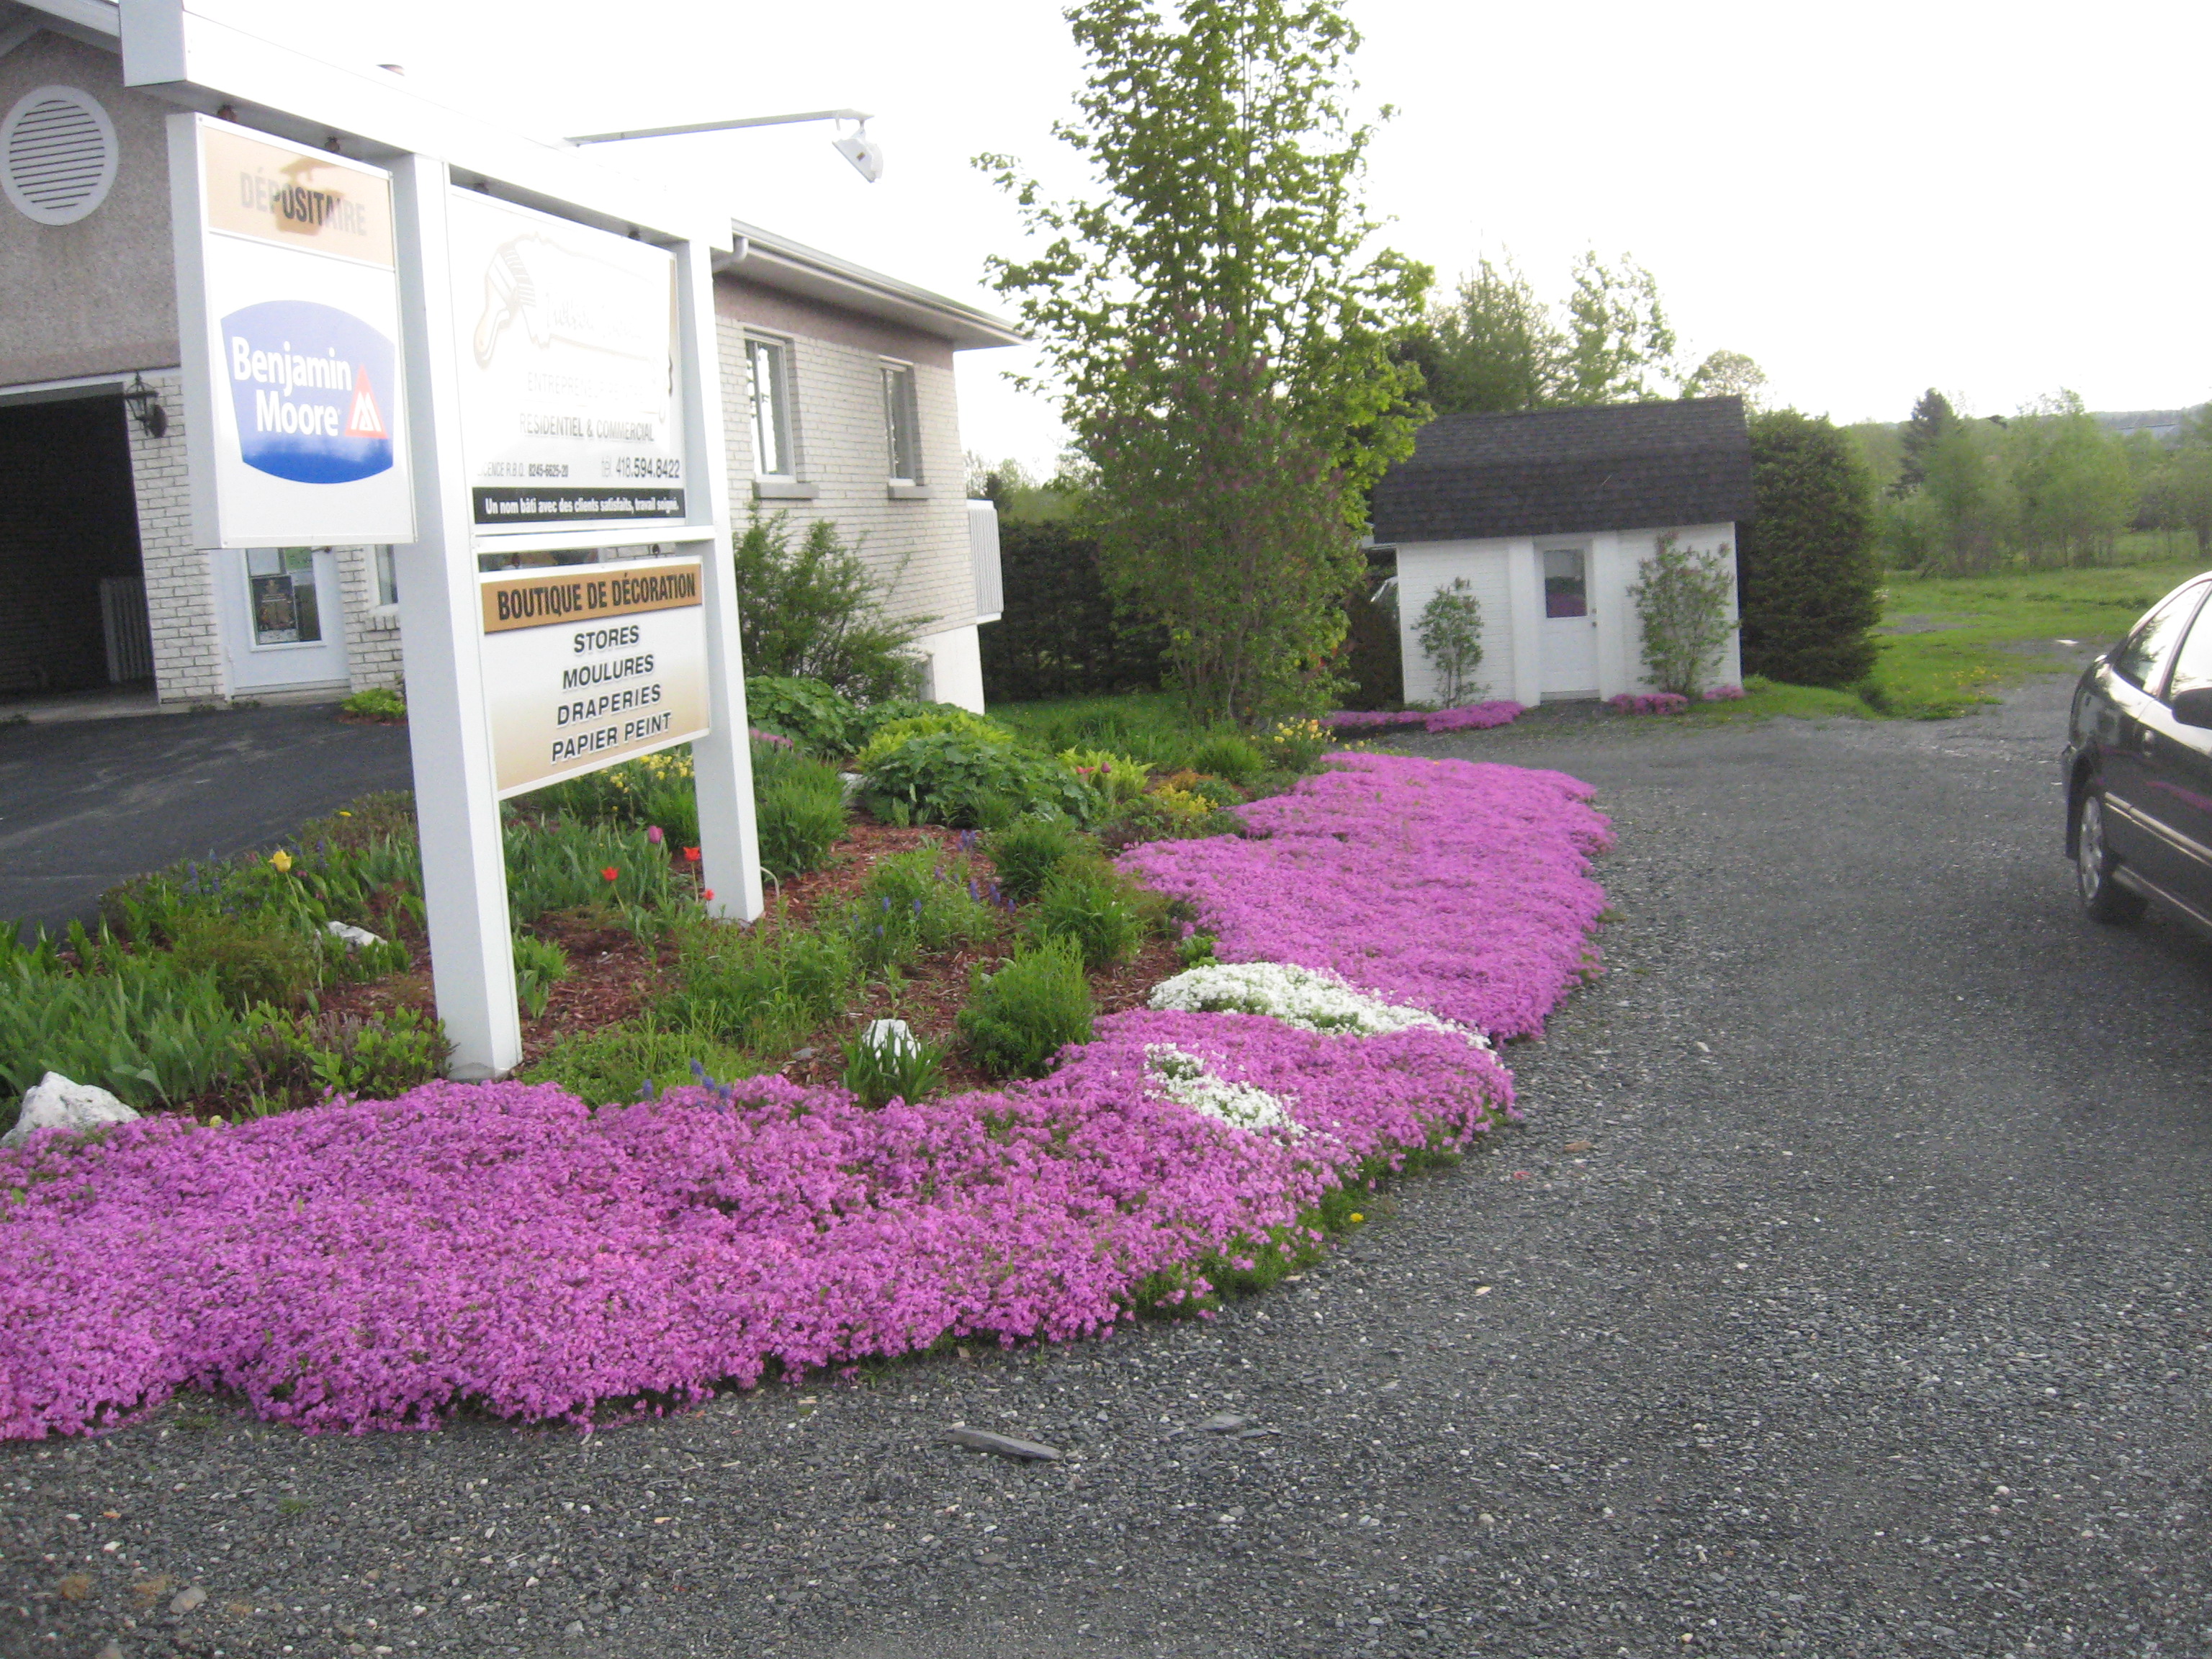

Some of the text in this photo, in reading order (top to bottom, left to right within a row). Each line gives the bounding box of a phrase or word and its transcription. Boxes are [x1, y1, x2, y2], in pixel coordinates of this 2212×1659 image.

[240, 167, 367, 236] DÉPOSITAIRE
[232, 336, 352, 397] Benjamin
[256, 390, 338, 437] Moore
[520, 413, 655, 442] RESIDENTIEL & COMMERCIAL
[616, 457, 680, 480] 418.594.8422
[485, 498, 498, 514] Un
[500, 500, 518, 513] nom
[520, 497, 536, 513] bâti
[538, 500, 557, 513] avec
[559, 498, 573, 513] des
[574, 497, 599, 512] clients
[634, 497, 656, 511] travail
[498, 572, 696, 620] BOUTIQUE DE DÉCORATION
[574, 625, 639, 652] STORES
[563, 654, 654, 689] MOULURES
[557, 684, 660, 725] DRAPERIES
[552, 712, 671, 761] PAPIER PEINT
